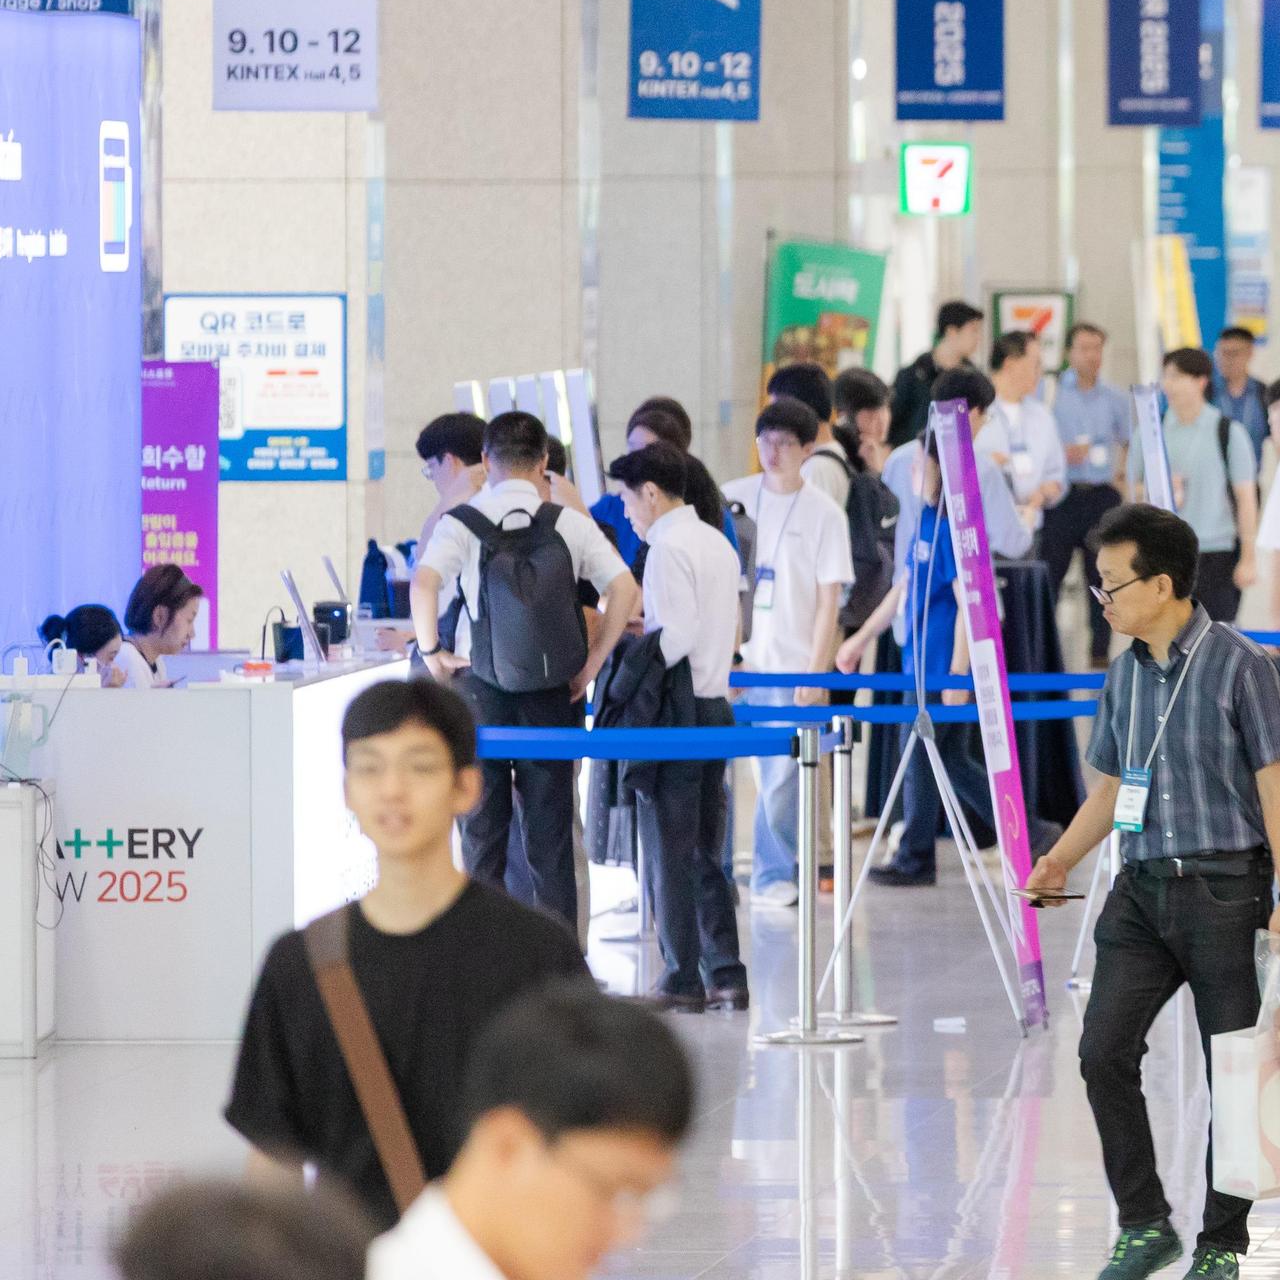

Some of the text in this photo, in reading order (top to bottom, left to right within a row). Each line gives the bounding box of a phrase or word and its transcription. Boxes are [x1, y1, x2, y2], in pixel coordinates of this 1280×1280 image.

[226, 63, 300, 81] KINTEX
[200, 312, 236, 334] QR
[97, 870, 188, 903] 2025
